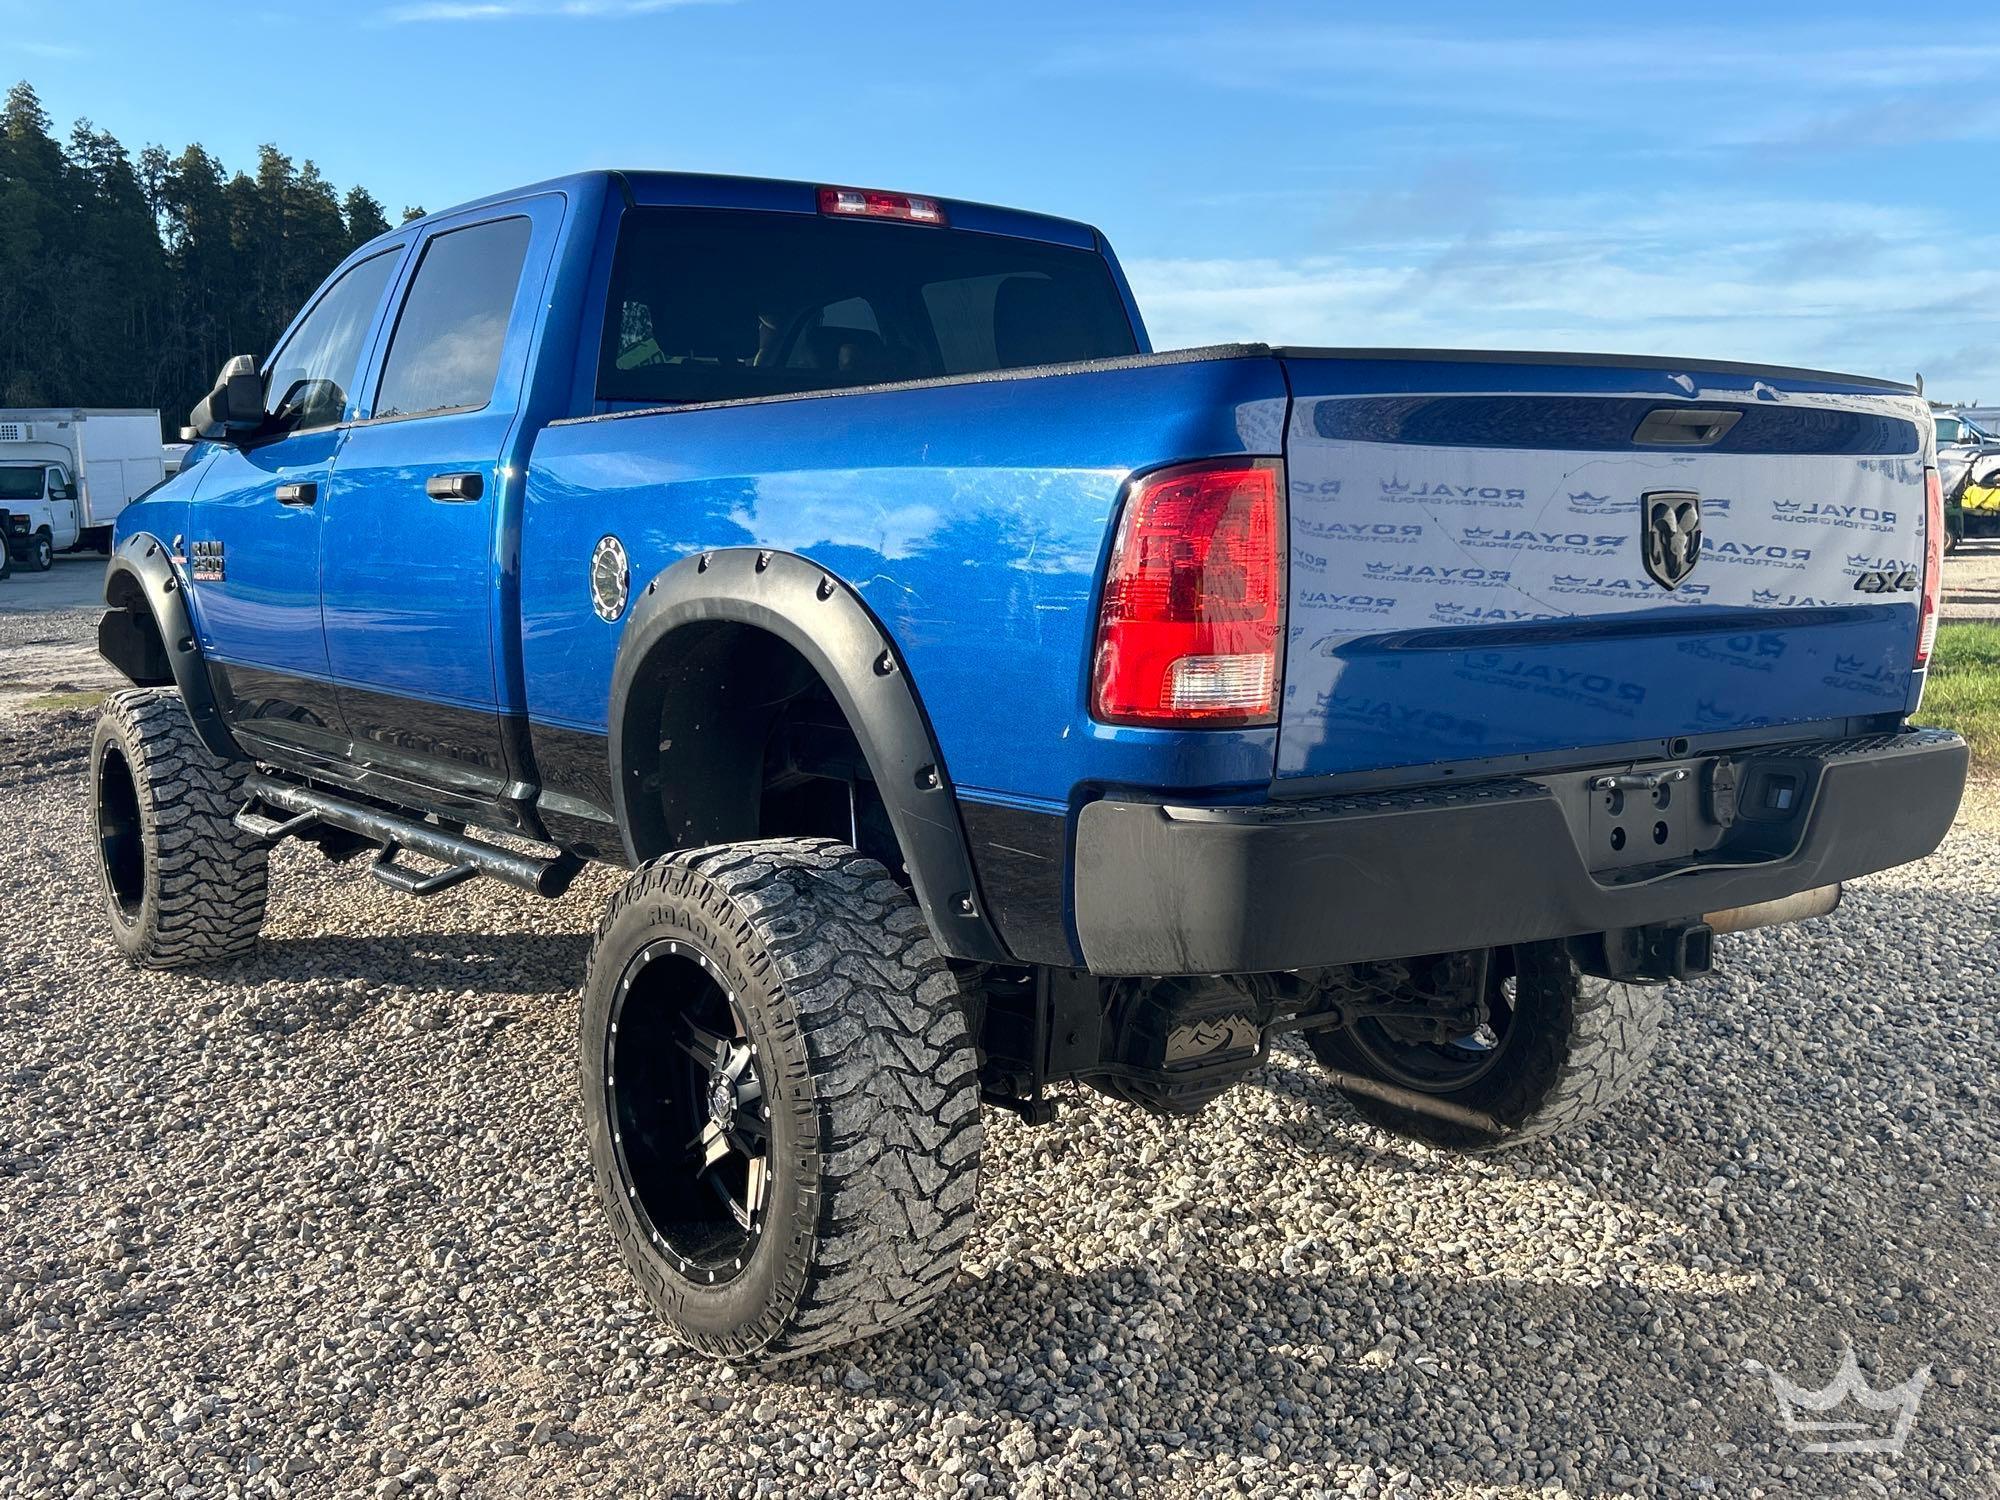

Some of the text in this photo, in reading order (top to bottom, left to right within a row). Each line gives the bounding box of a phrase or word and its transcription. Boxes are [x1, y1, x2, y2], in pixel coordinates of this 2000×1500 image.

[192, 541, 224, 556] RAM
[1854, 572, 1919, 593] 4X4
[647, 904, 748, 993] ROADIAN
